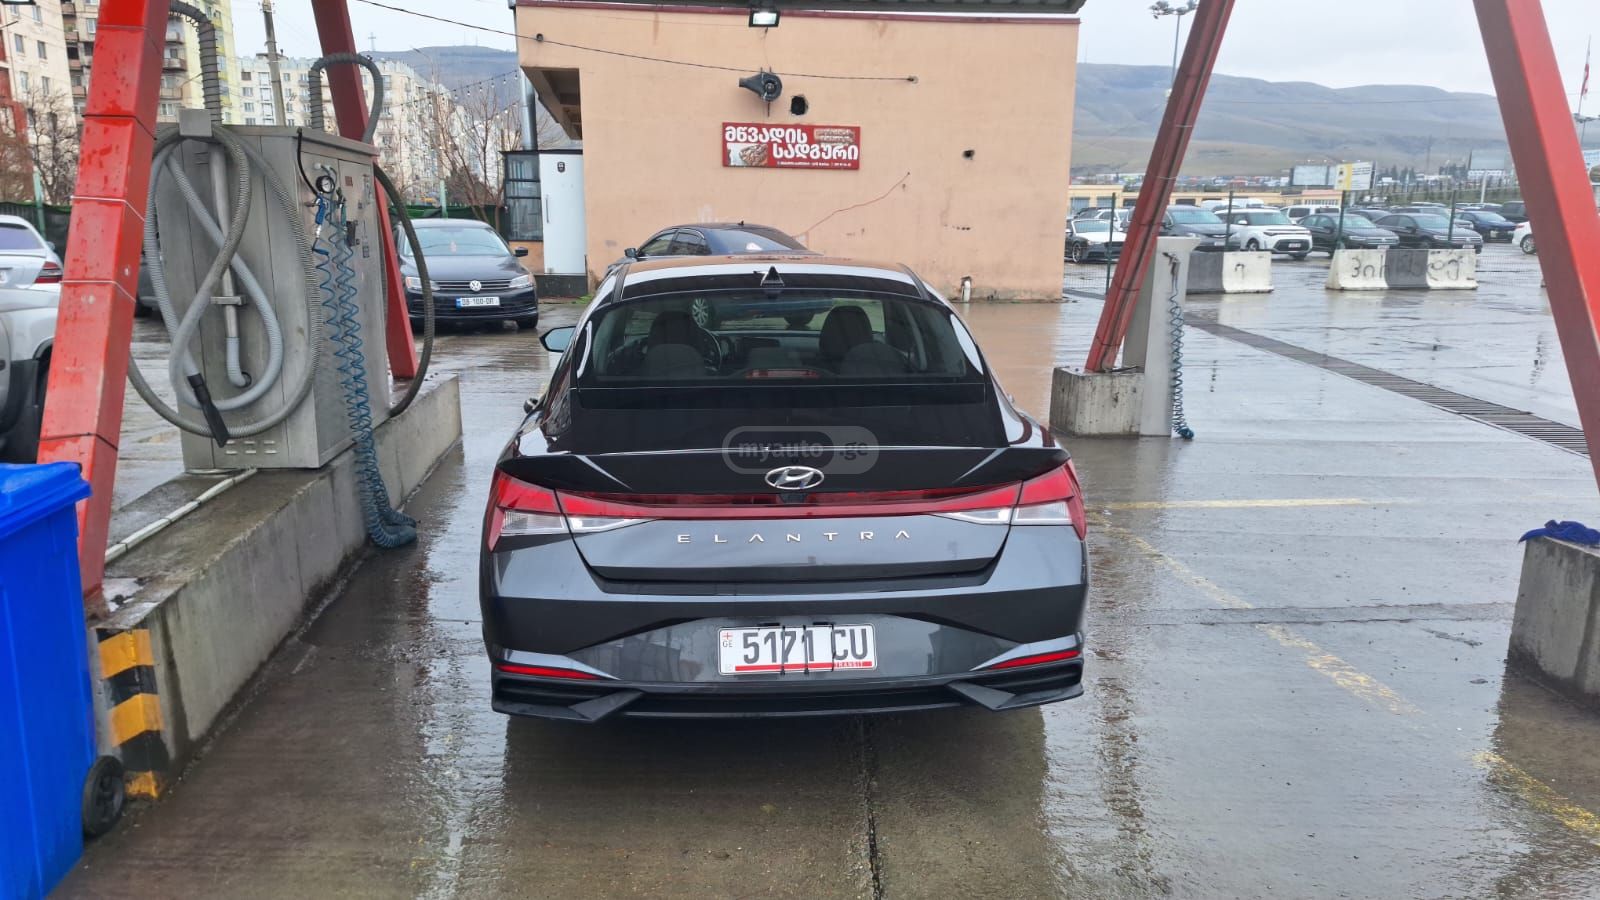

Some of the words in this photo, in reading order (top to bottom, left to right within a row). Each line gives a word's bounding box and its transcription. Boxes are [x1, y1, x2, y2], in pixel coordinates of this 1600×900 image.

[725, 126, 808, 144] მწვადის
[772, 143, 859, 161] სადგური
[677, 530, 911, 544] ELANTRA
[722, 640, 733, 648] GE
[743, 630, 815, 664] 5171
[831, 628, 868, 661] CU
